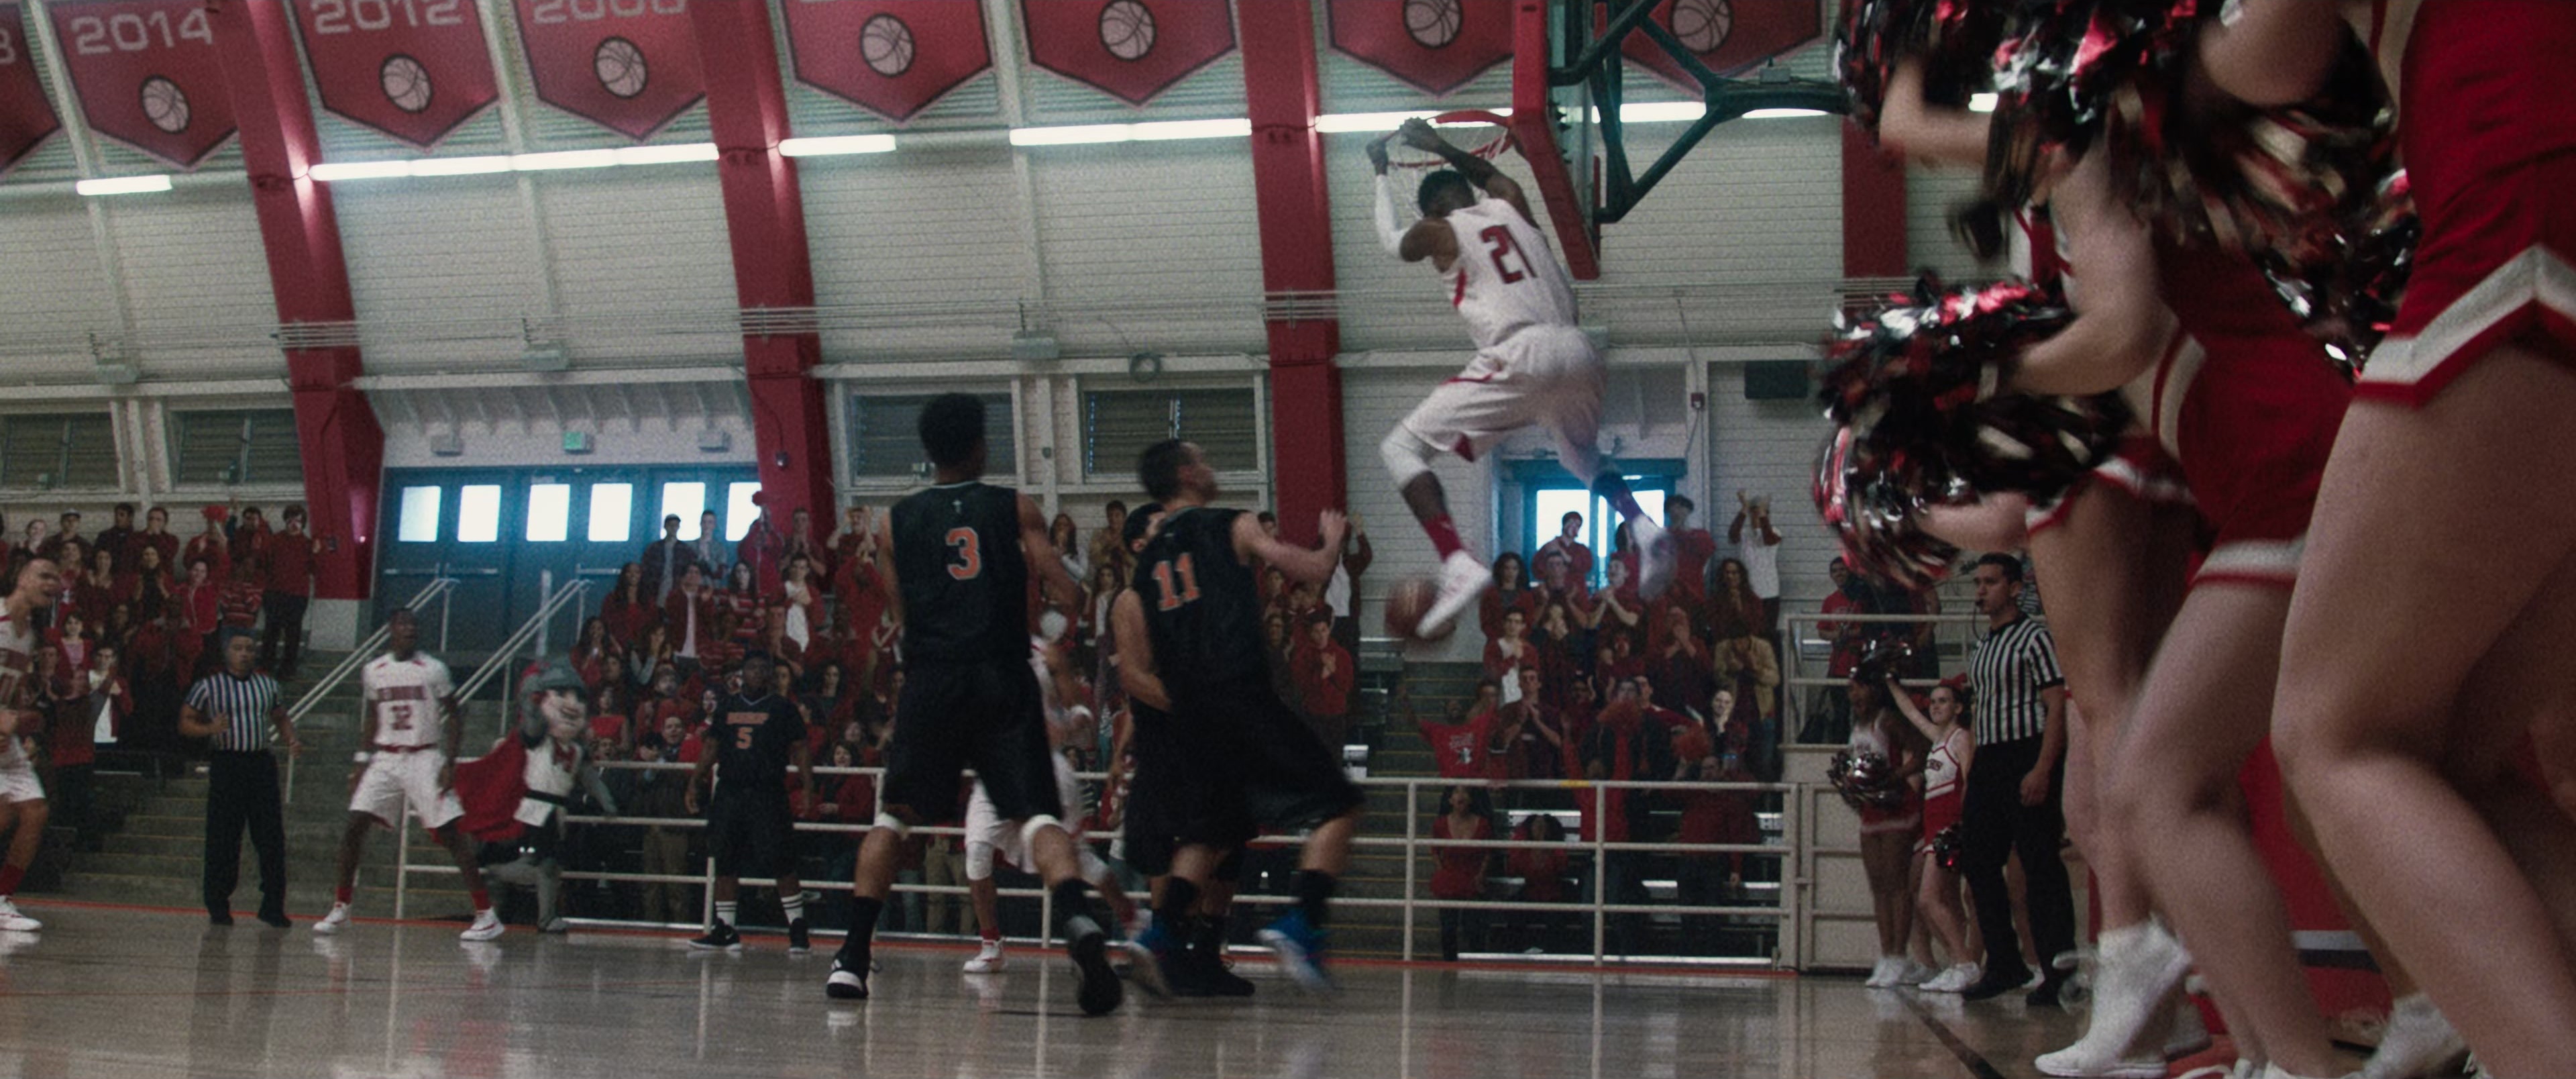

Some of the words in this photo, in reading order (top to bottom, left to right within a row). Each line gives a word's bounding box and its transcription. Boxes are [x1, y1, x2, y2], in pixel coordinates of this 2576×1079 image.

[70, 7, 213, 55] 2014
[1480, 224, 1538, 285] 21
[945, 527, 981, 580] 3
[1152, 552, 1202, 611] 11
[736, 727, 753, 750] 5
